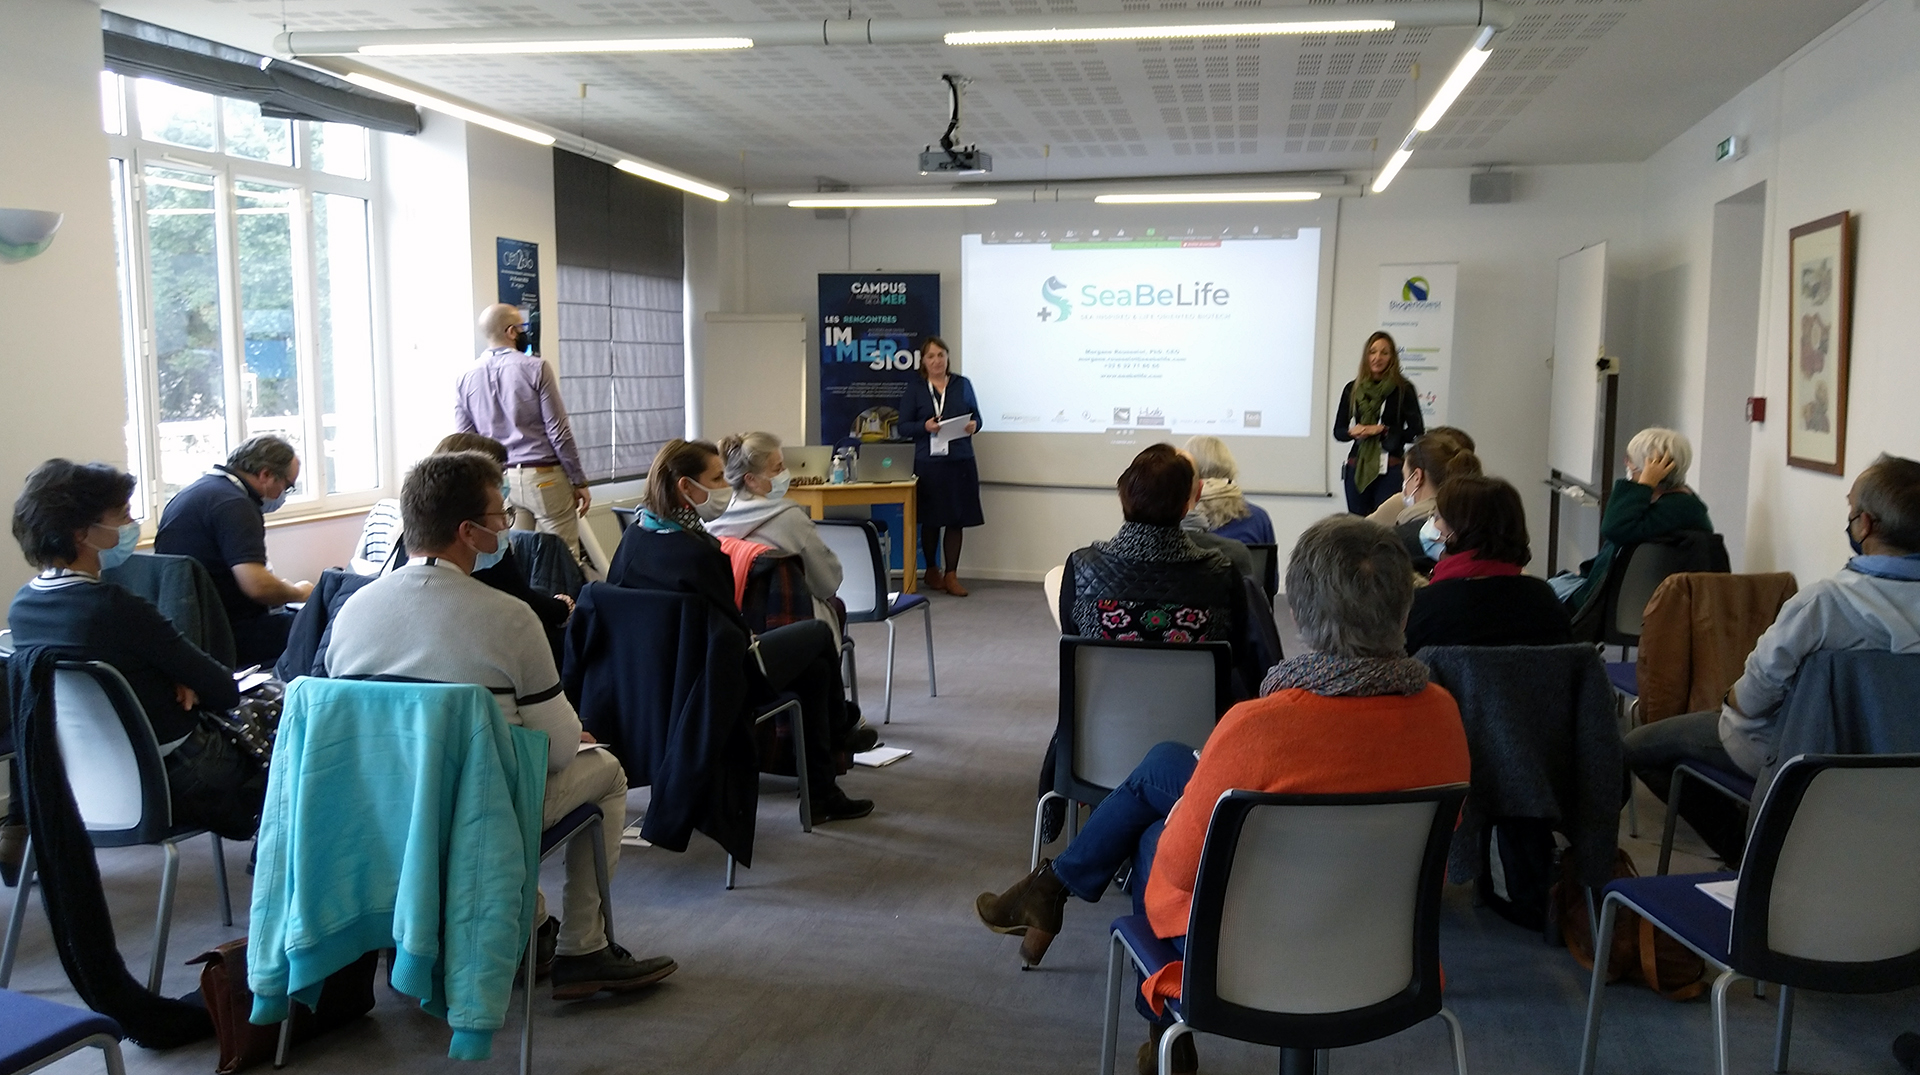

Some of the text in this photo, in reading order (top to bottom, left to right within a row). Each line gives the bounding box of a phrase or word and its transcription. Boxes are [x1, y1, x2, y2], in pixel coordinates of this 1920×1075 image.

[850, 282, 907, 294] CAMPUS
[1080, 281, 1230, 307] SeaBeLife
[880, 293, 907, 305] MER
[824, 315, 898, 324] LES RENCONTRES
[825, 327, 852, 347] IM
[836, 339, 898, 362] MER
